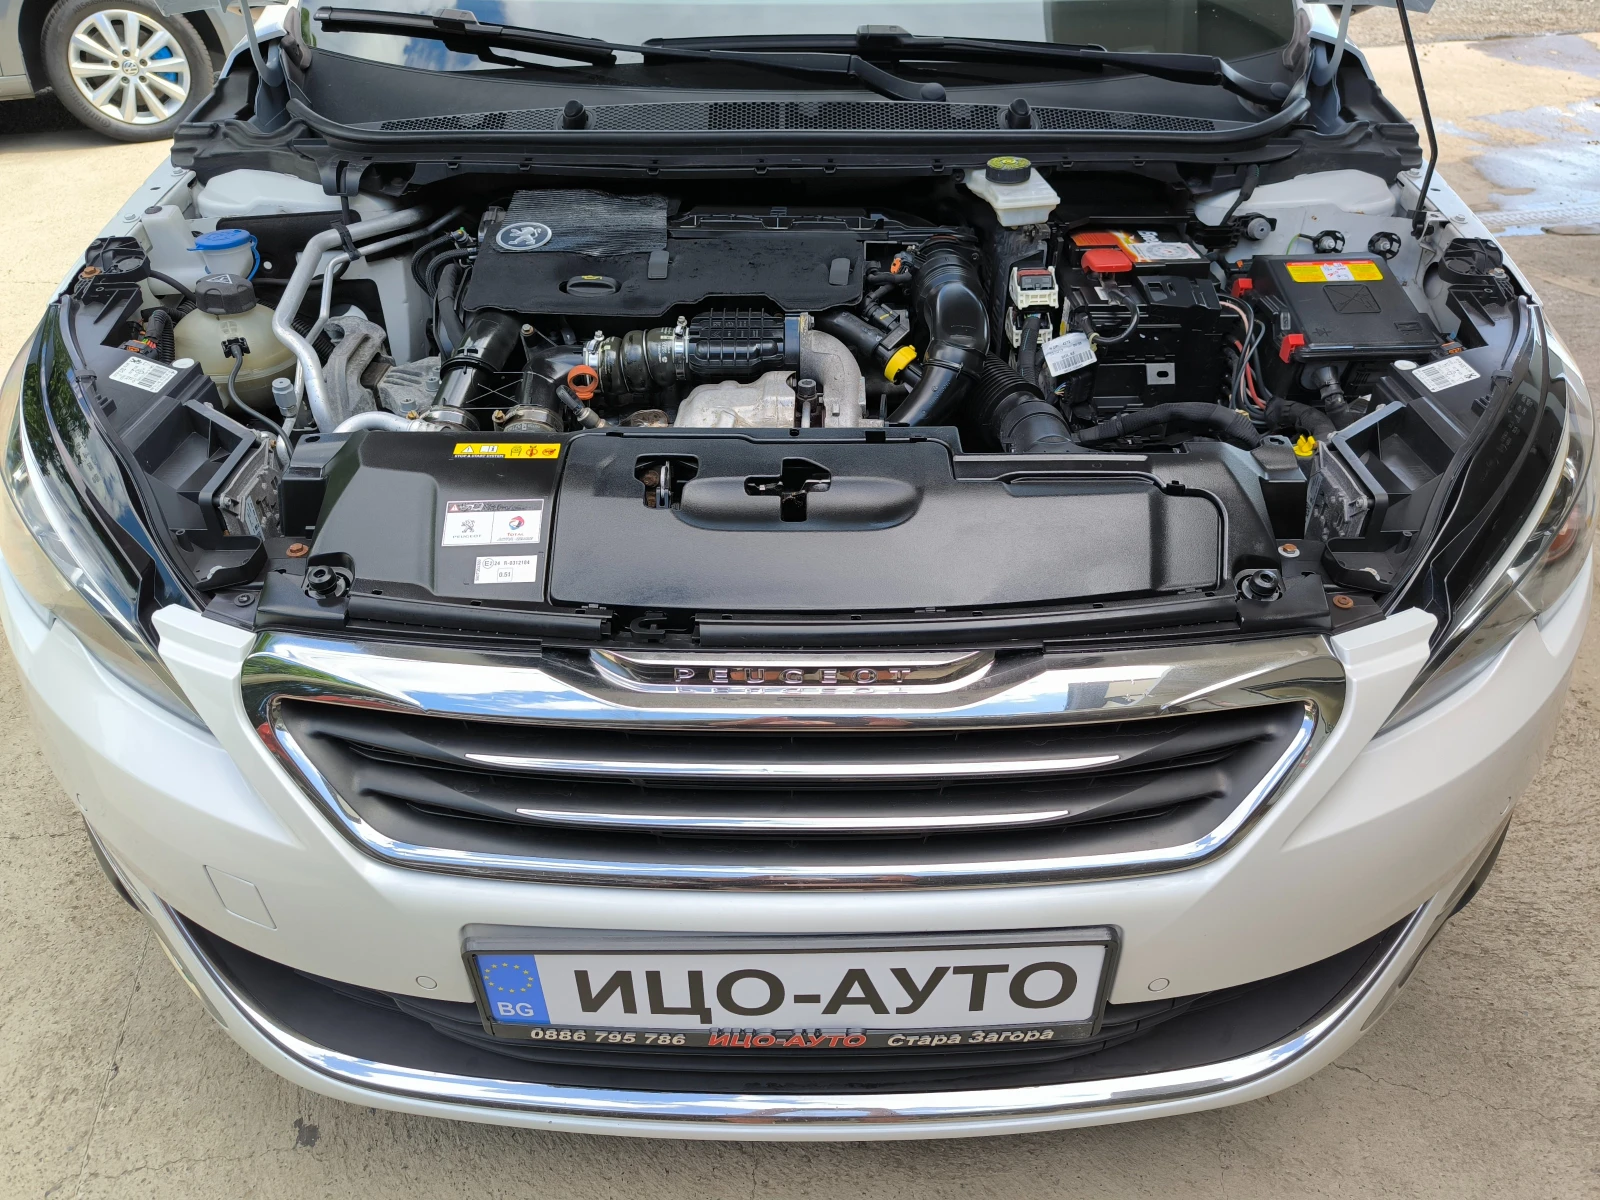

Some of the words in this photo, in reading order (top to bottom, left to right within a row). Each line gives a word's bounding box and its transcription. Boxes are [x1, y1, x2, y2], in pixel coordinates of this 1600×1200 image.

[673, 667, 911, 684] PEUGEOT
[573, 961, 1078, 1025] ИЦО-АУТО
[496, 1001, 535, 1020] BG
[530, 1027, 587, 1042] 0886
[594, 1030, 637, 1044] 795
[644, 1032, 686, 1046] 786
[707, 1033, 867, 1049] ИЦО-АУТО
[887, 1032, 962, 1047] Стара
[968, 1028, 1055, 1045] Загора
